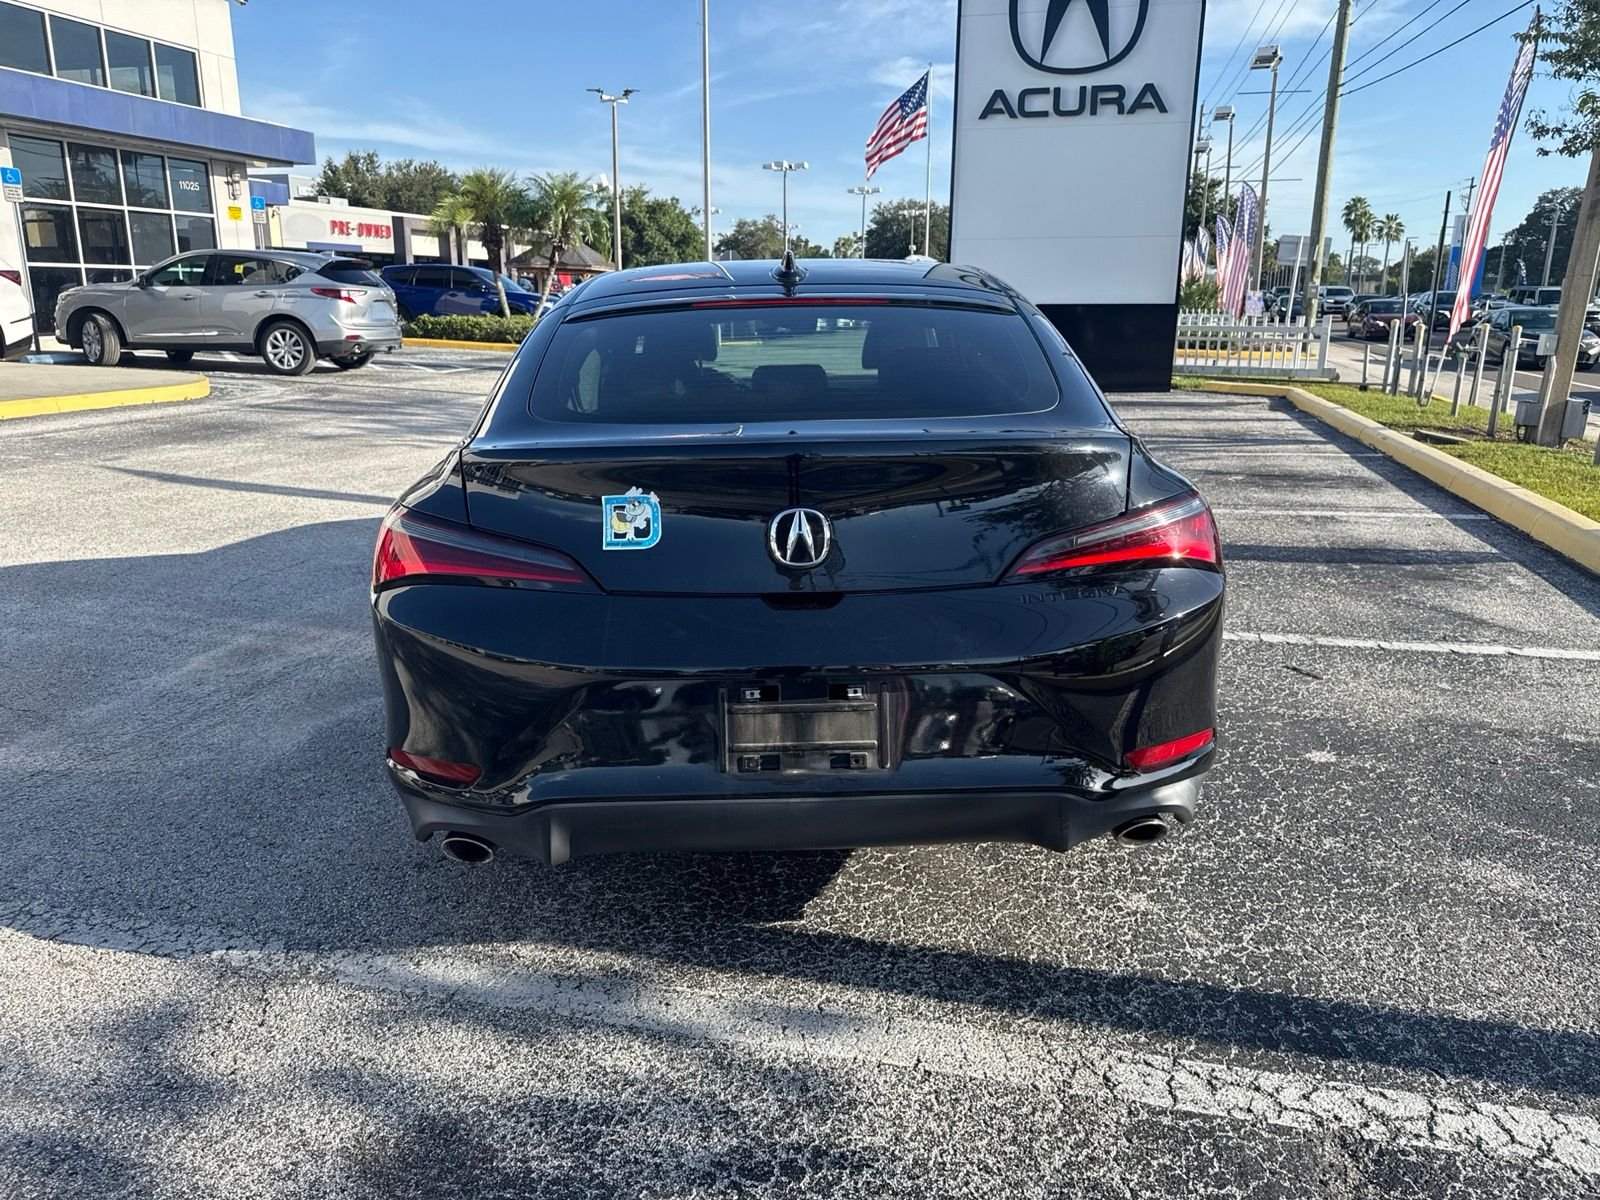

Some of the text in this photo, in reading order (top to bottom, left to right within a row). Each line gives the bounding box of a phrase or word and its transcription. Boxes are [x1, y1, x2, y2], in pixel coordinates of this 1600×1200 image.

[978, 83, 1168, 120] ACURA
[179, 180, 200, 191] 11025
[330, 220, 391, 239] PRE-OWNED
